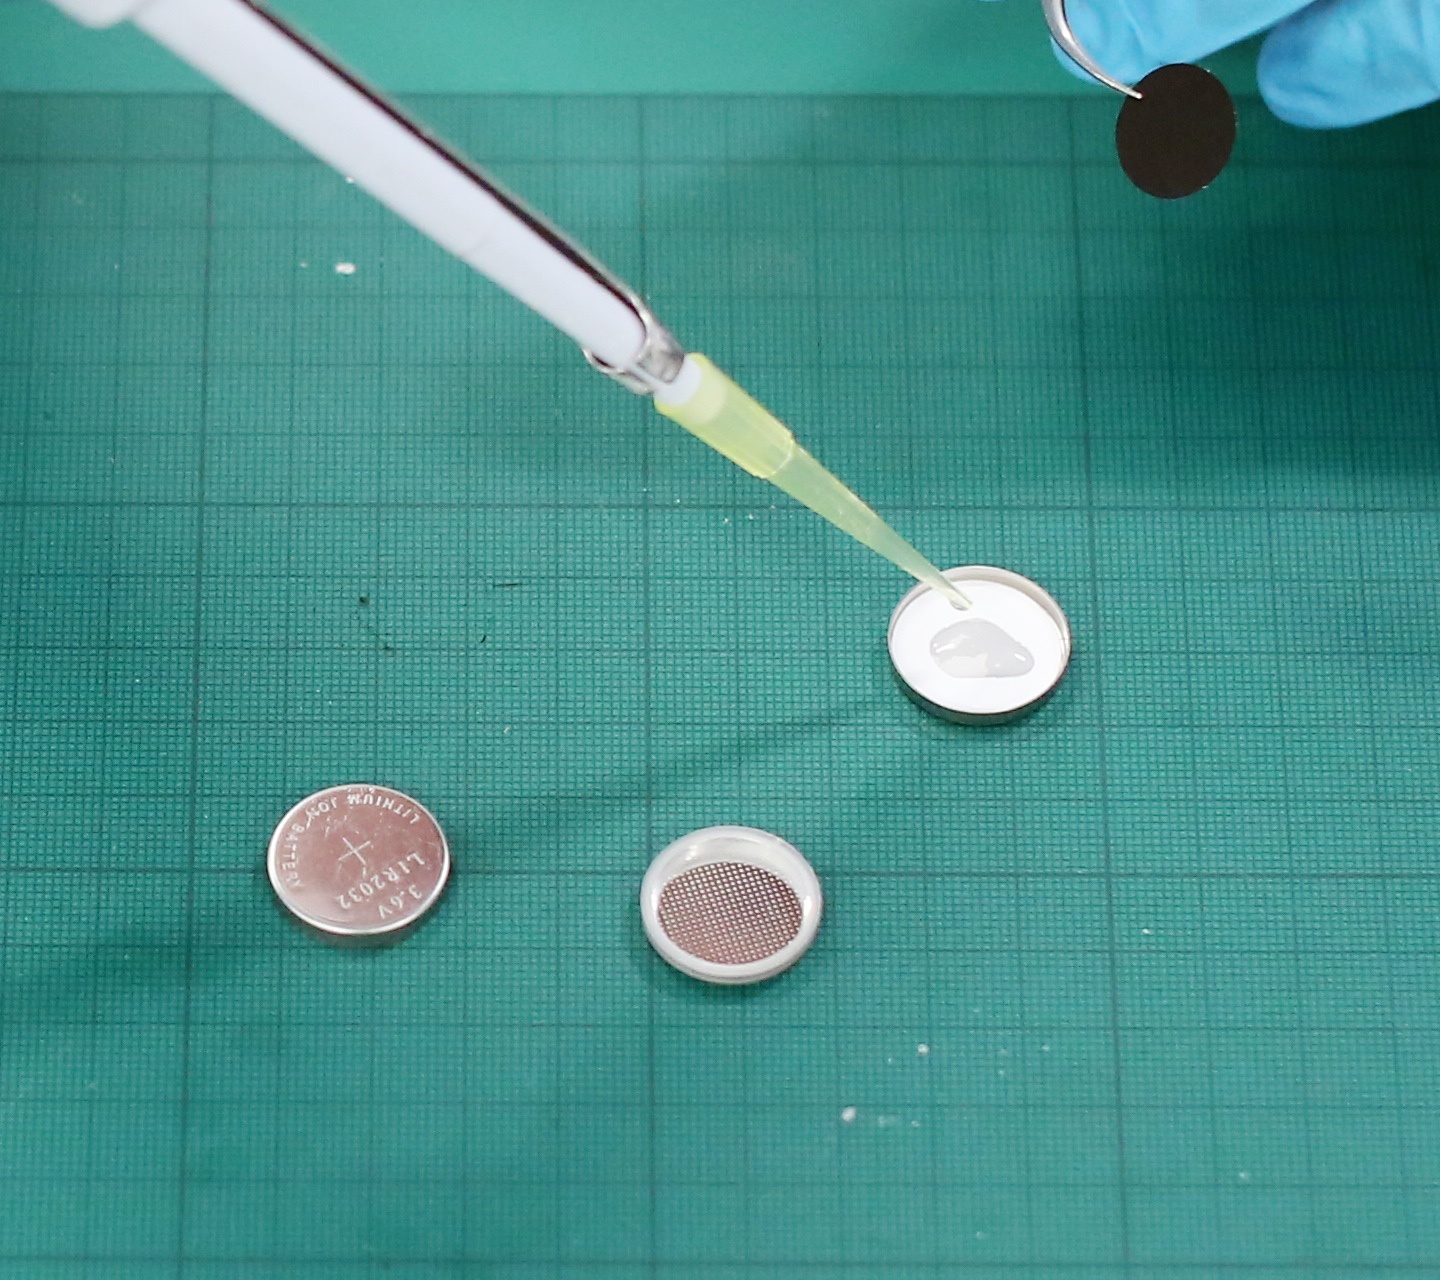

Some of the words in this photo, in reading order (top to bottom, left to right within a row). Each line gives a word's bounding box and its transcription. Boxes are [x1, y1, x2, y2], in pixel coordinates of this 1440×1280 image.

[347, 793, 420, 824] LITHIUM
[282, 823, 305, 888] BATTERY
[337, 852, 426, 909] LIR2032
[378, 884, 422, 919] 3.6V
